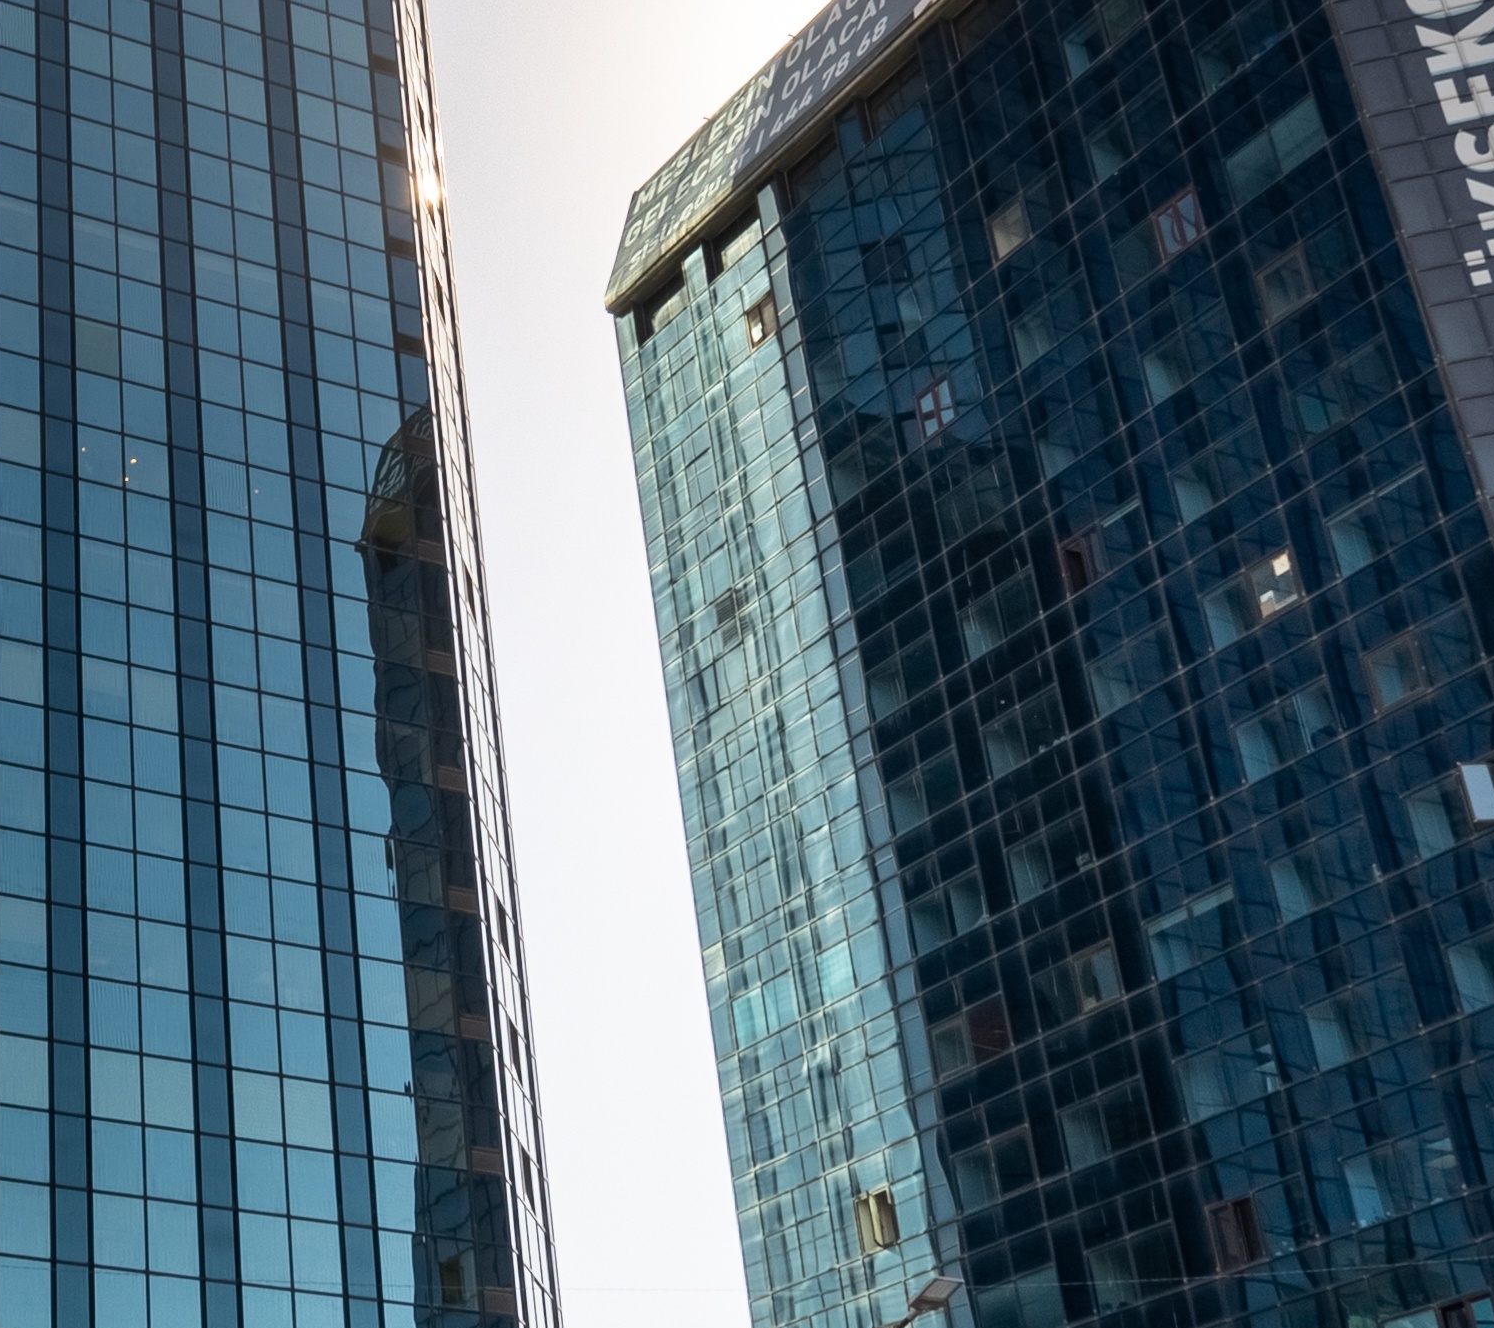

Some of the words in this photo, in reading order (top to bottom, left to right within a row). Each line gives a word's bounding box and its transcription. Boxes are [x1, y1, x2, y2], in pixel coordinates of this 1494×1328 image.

[634, 59, 776, 215] MESLEĞİN
[770, 88, 814, 138] 444
[821, 51, 850, 92] 78
[856, 17, 888, 58] 68
[625, 101, 773, 248] GELECEĞİN
